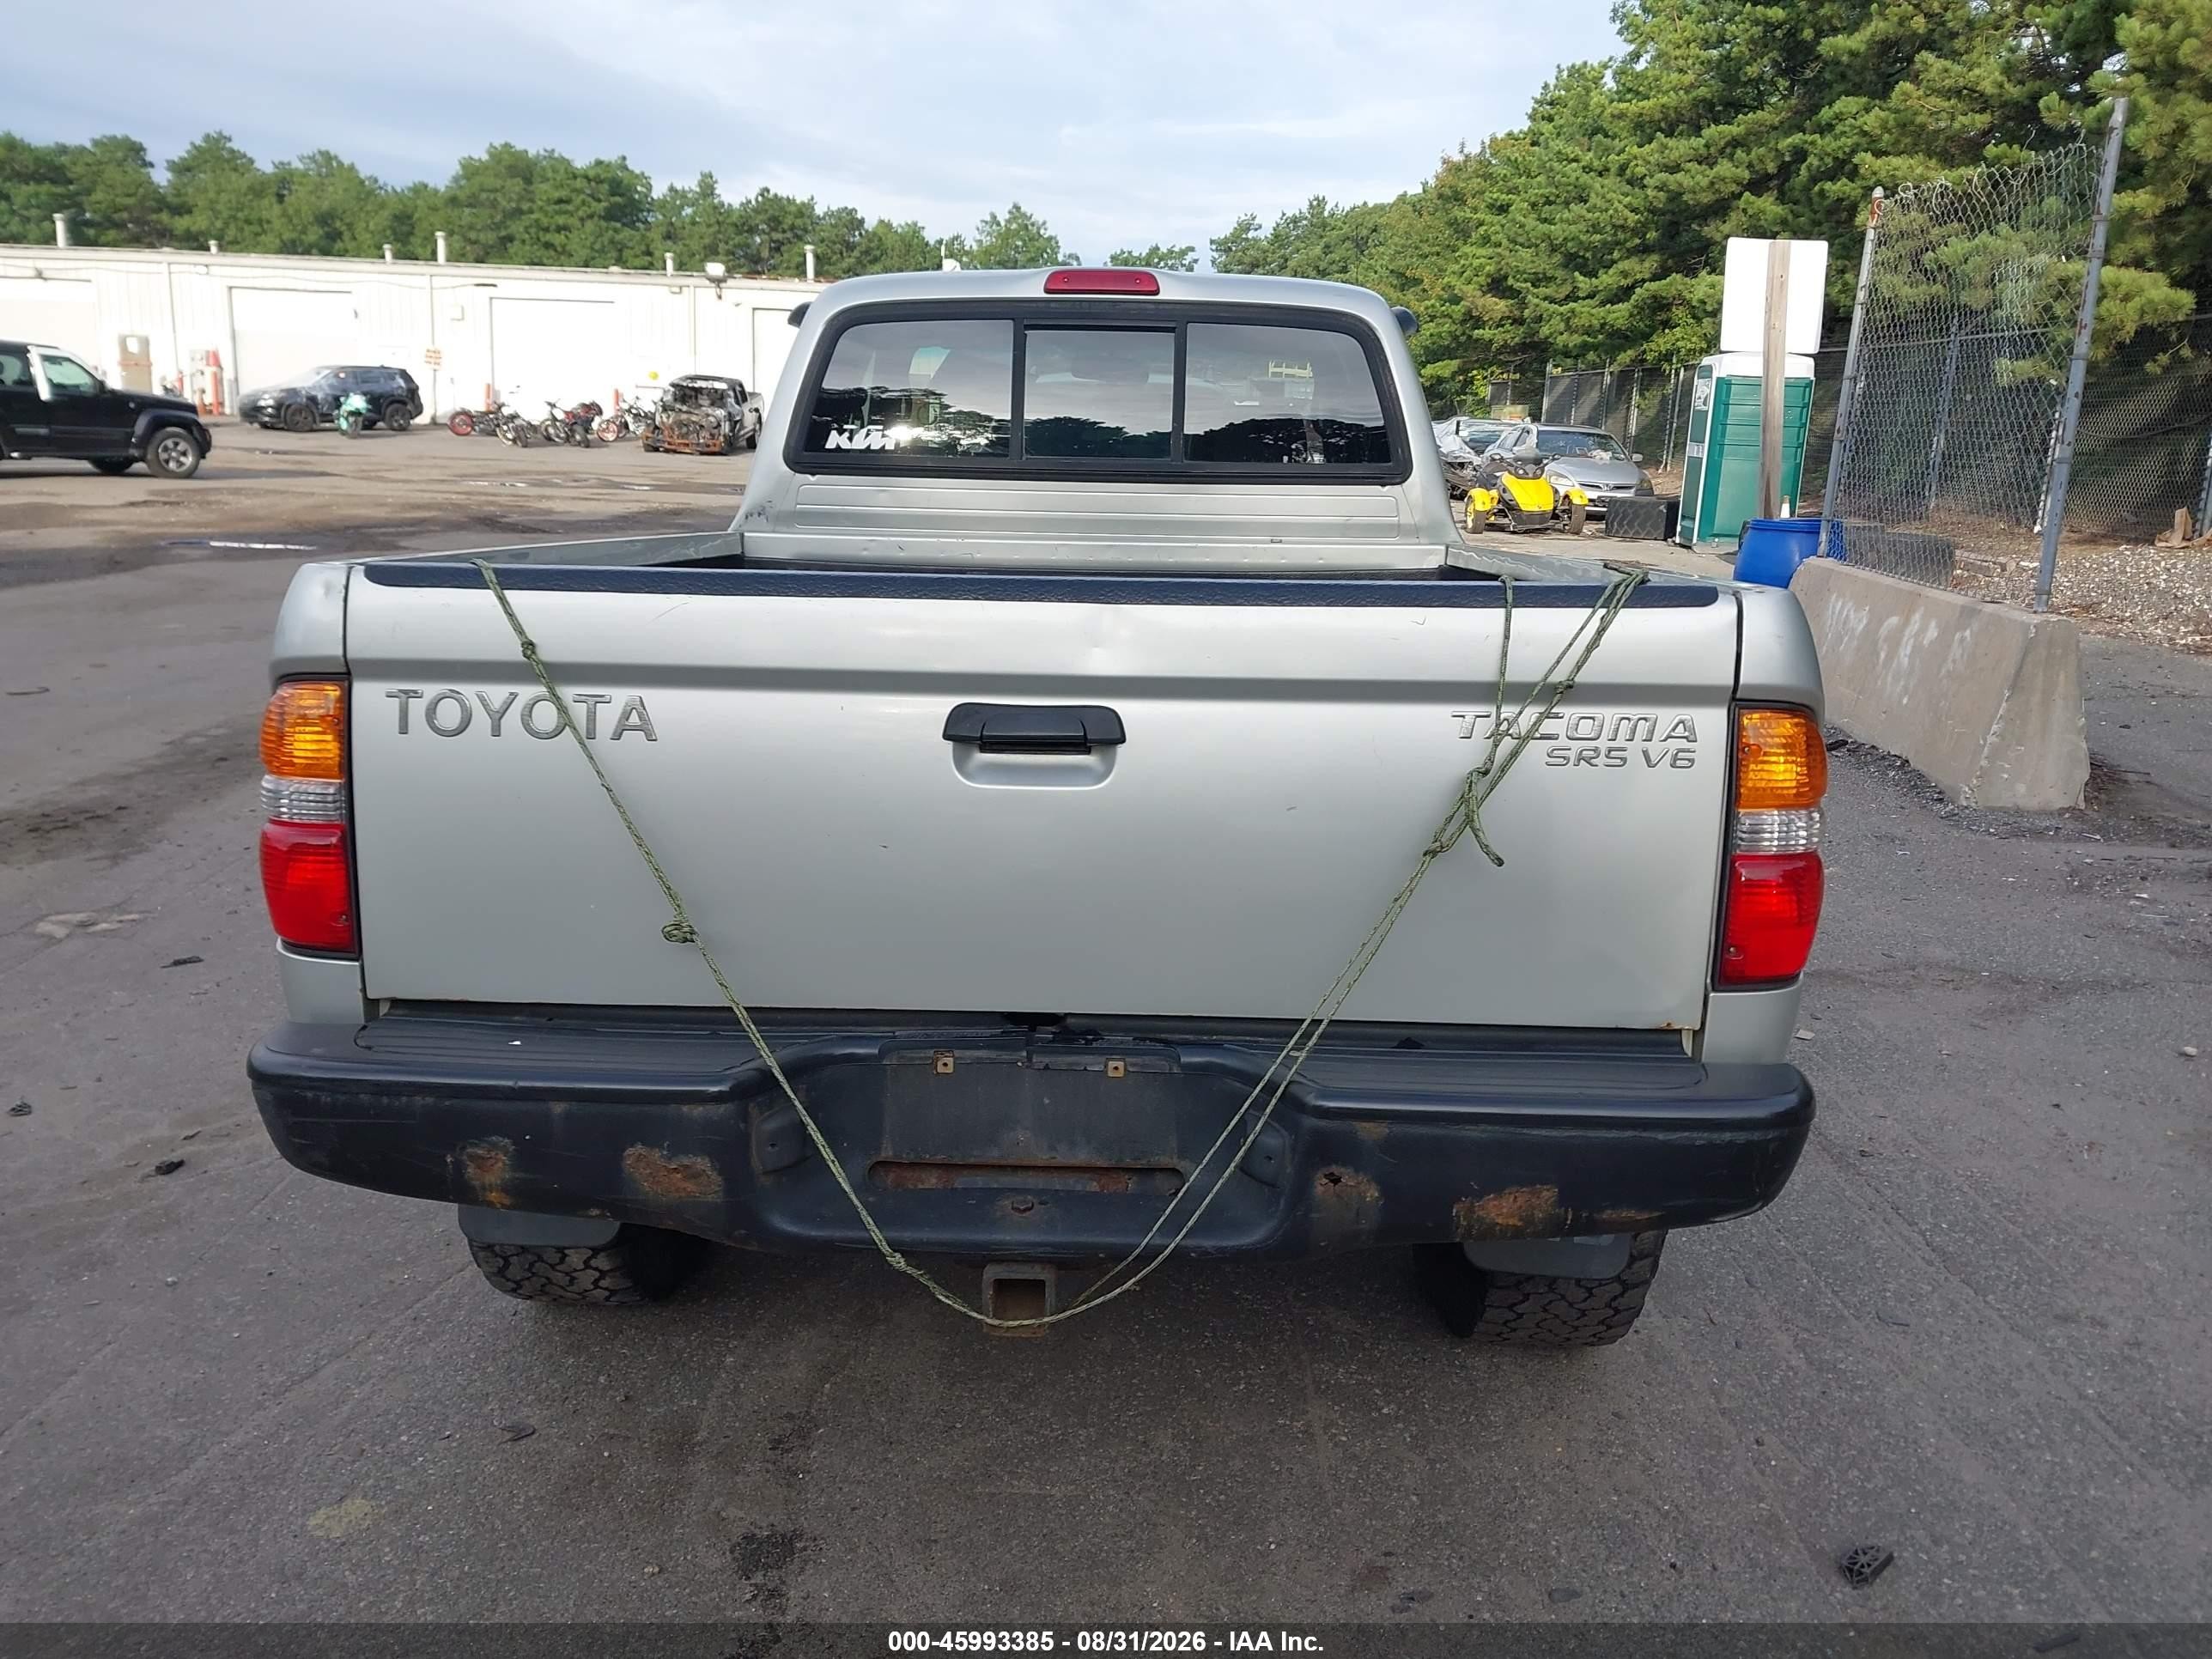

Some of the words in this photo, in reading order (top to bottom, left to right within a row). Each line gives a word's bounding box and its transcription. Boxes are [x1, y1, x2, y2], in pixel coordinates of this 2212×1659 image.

[824, 425, 896, 450] KTM
[385, 688, 658, 742] TOYOTA
[1450, 710, 1698, 744] TACOMA
[1545, 745, 1628, 768] SR5
[1641, 746, 1697, 769] V6
